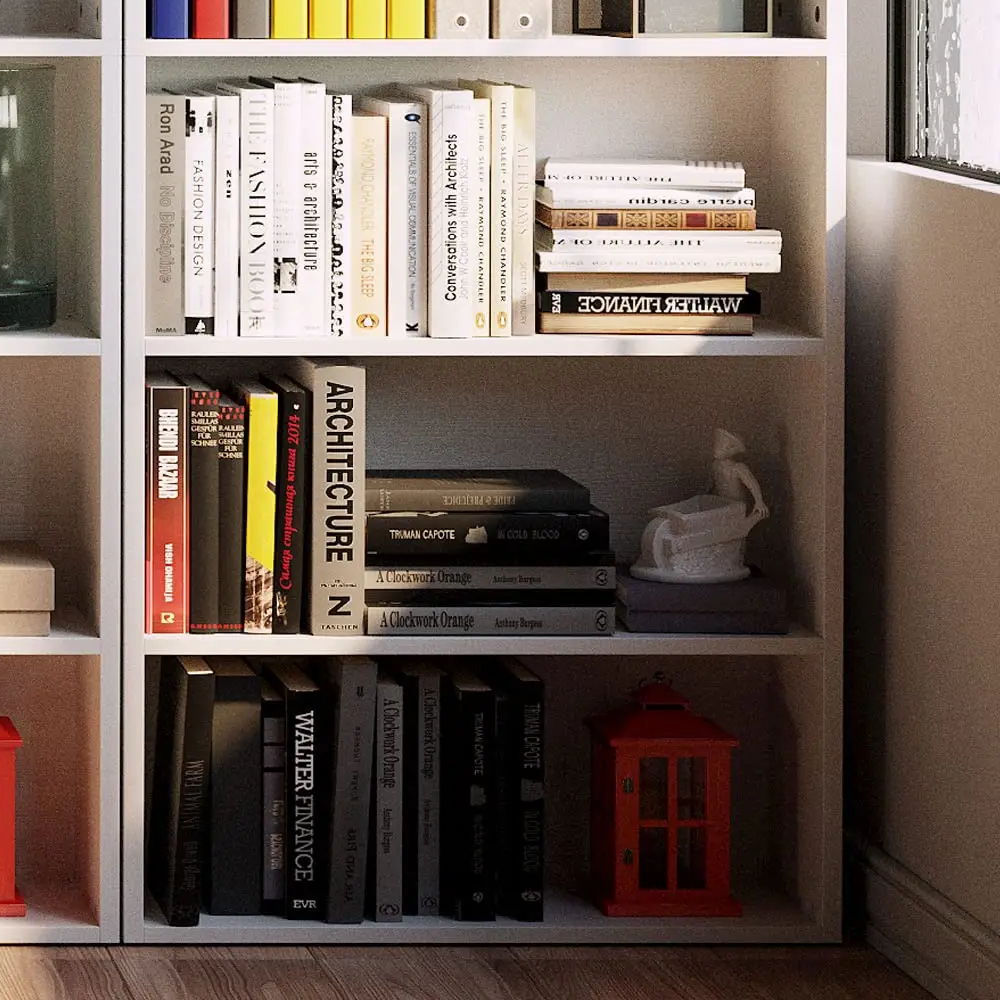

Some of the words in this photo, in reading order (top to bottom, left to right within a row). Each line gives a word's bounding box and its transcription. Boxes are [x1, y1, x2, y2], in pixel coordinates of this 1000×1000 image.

[160, 103, 175, 133] Ron
[248, 94, 267, 144] THE
[160, 138, 175, 175] Arad
[303, 152, 320, 176] arts
[408, 132, 417, 175] ESSENTIALS
[444, 134, 457, 191] Architects
[160, 185, 175, 207] No
[192, 160, 204, 220] FASHION
[248, 151, 267, 255] FASHION
[444, 194, 457, 218] with
[156, 211, 175, 284] Discipline
[192, 224, 204, 277] DESIGN
[302, 196, 320, 271] architecture
[360, 239, 375, 255] THE
[408, 214, 417, 278] COMMUNICATION
[360, 257, 375, 272] BIG
[444, 220, 457, 302] Conversations
[360, 275, 375, 298] SLEEP
[158, 408, 179, 452] BHENDI
[287, 414, 301, 445] 2014
[158, 455, 179, 499] BAZAAR
[326, 381, 354, 563] ARCHITECTURE
[281, 485, 298, 547] страшная
[442, 494, 484, 506] PREJUDICE
[493, 495, 516, 506] PRIDE
[389, 529, 421, 540] TRUMAN
[422, 529, 456, 540] CAPOTE
[279, 550, 293, 590] Самая
[376, 570, 384, 583] A
[386, 569, 436, 584] Clockwork
[437, 570, 472, 585] Orange
[380, 612, 388, 628] A
[390, 611, 439, 628] Clockwork
[440, 611, 474, 631] Orange
[384, 698, 399, 706] A
[524, 702, 541, 735] TRUMAN
[383, 706, 400, 755] Clockwork
[424, 696, 436, 744] Clockwork
[294, 710, 314, 791] WALTER
[422, 746, 436, 780] Orange
[524, 736, 541, 770] CAPOTE
[186, 759, 205, 788] FARM
[380, 756, 400, 789] Orange
[294, 796, 314, 882] FINANCE
[293, 900, 317, 909] EVR
